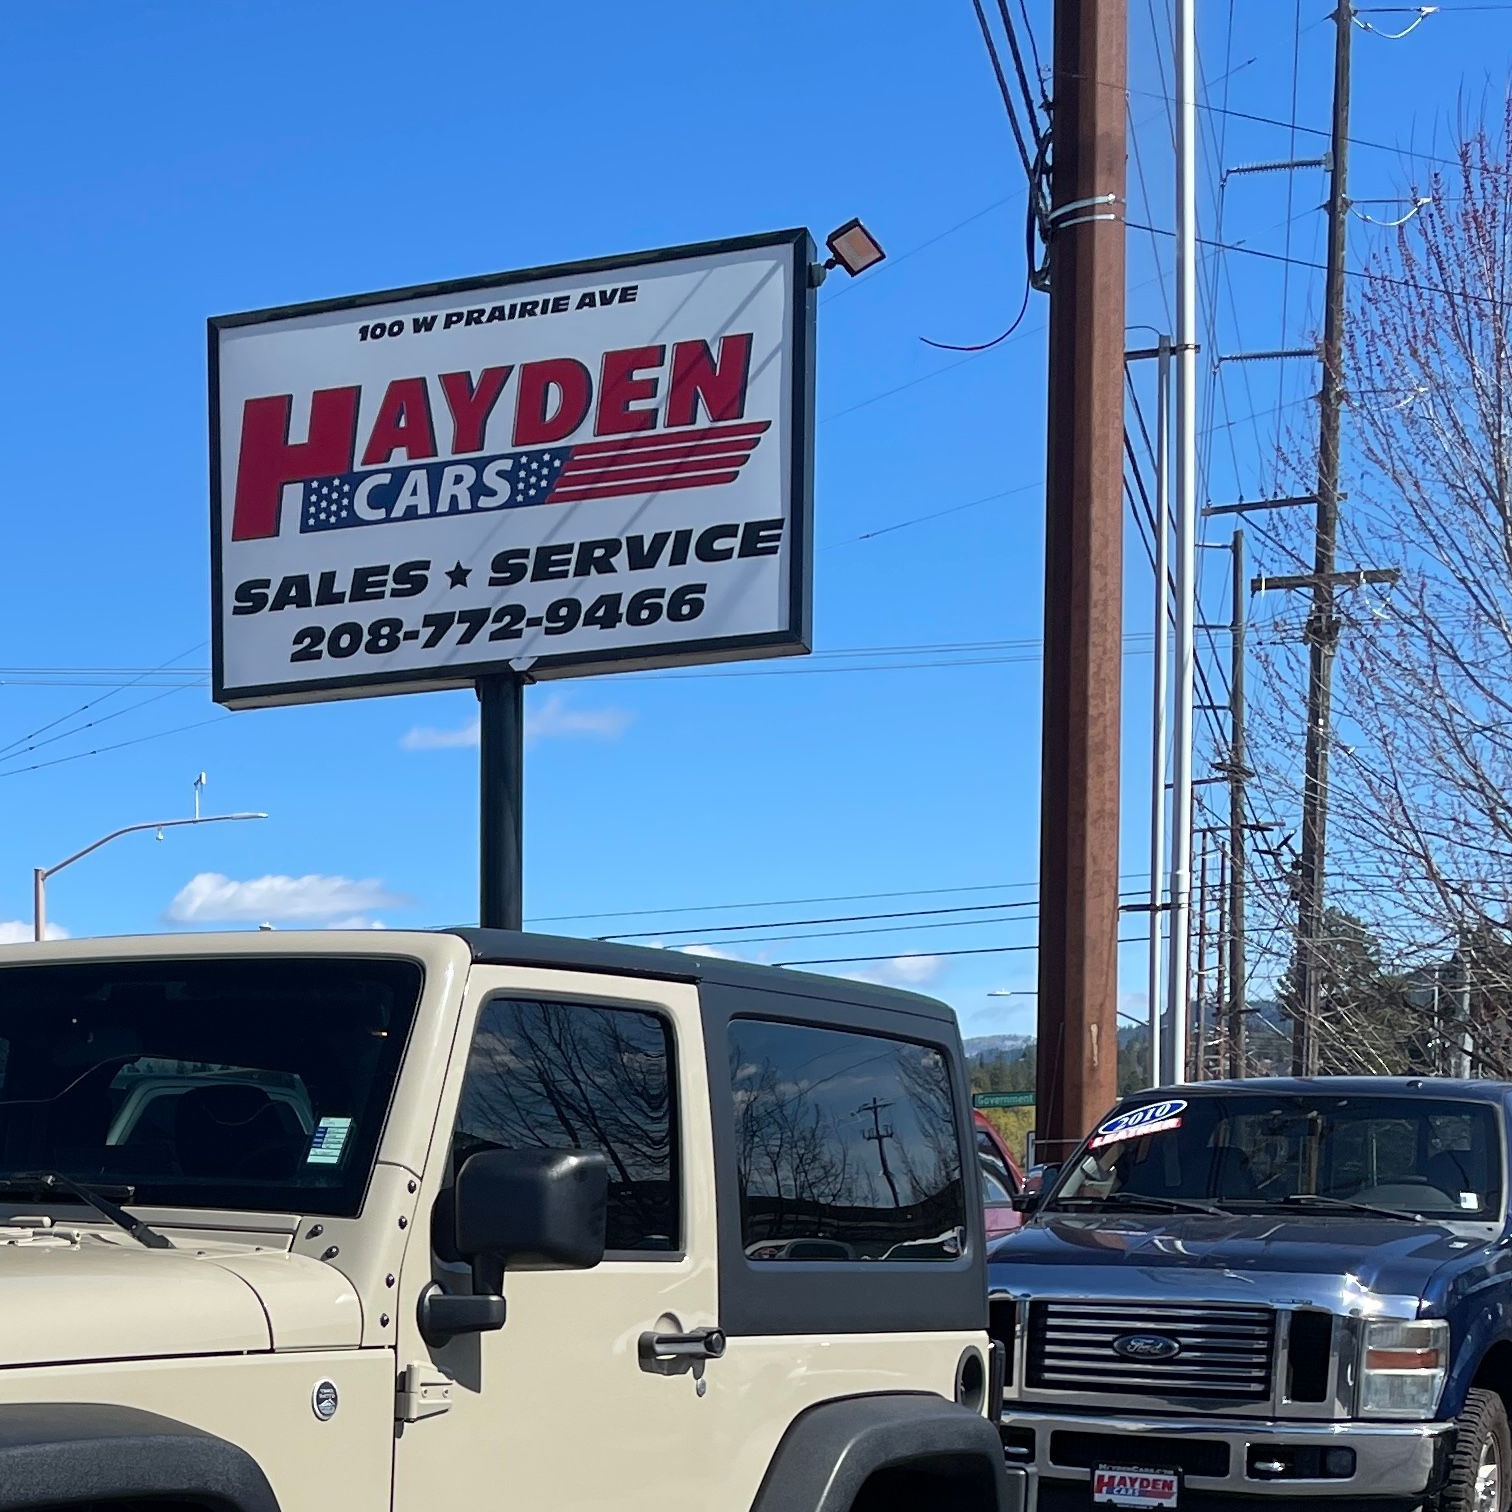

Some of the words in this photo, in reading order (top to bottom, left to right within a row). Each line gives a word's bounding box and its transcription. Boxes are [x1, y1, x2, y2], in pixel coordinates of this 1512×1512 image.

[359, 319, 405, 341] 100
[412, 314, 438, 334] W
[443, 295, 571, 330] PRAIRIE
[575, 285, 639, 312] AVE
[231, 332, 754, 542] HAYDEN
[353, 457, 514, 522] CARS
[231, 559, 432, 616] SALES
[487, 518, 786, 587] SERVICE
[289, 583, 708, 663] 208-772-9466
[977, 1094, 1034, 1105] Government
[1113, 1103, 1172, 1129] 2010
[1126, 1339, 1164, 1353] Ford
[1095, 1474, 1174, 1494] HAYDEN
[1113, 1487, 1140, 1497] CARS
